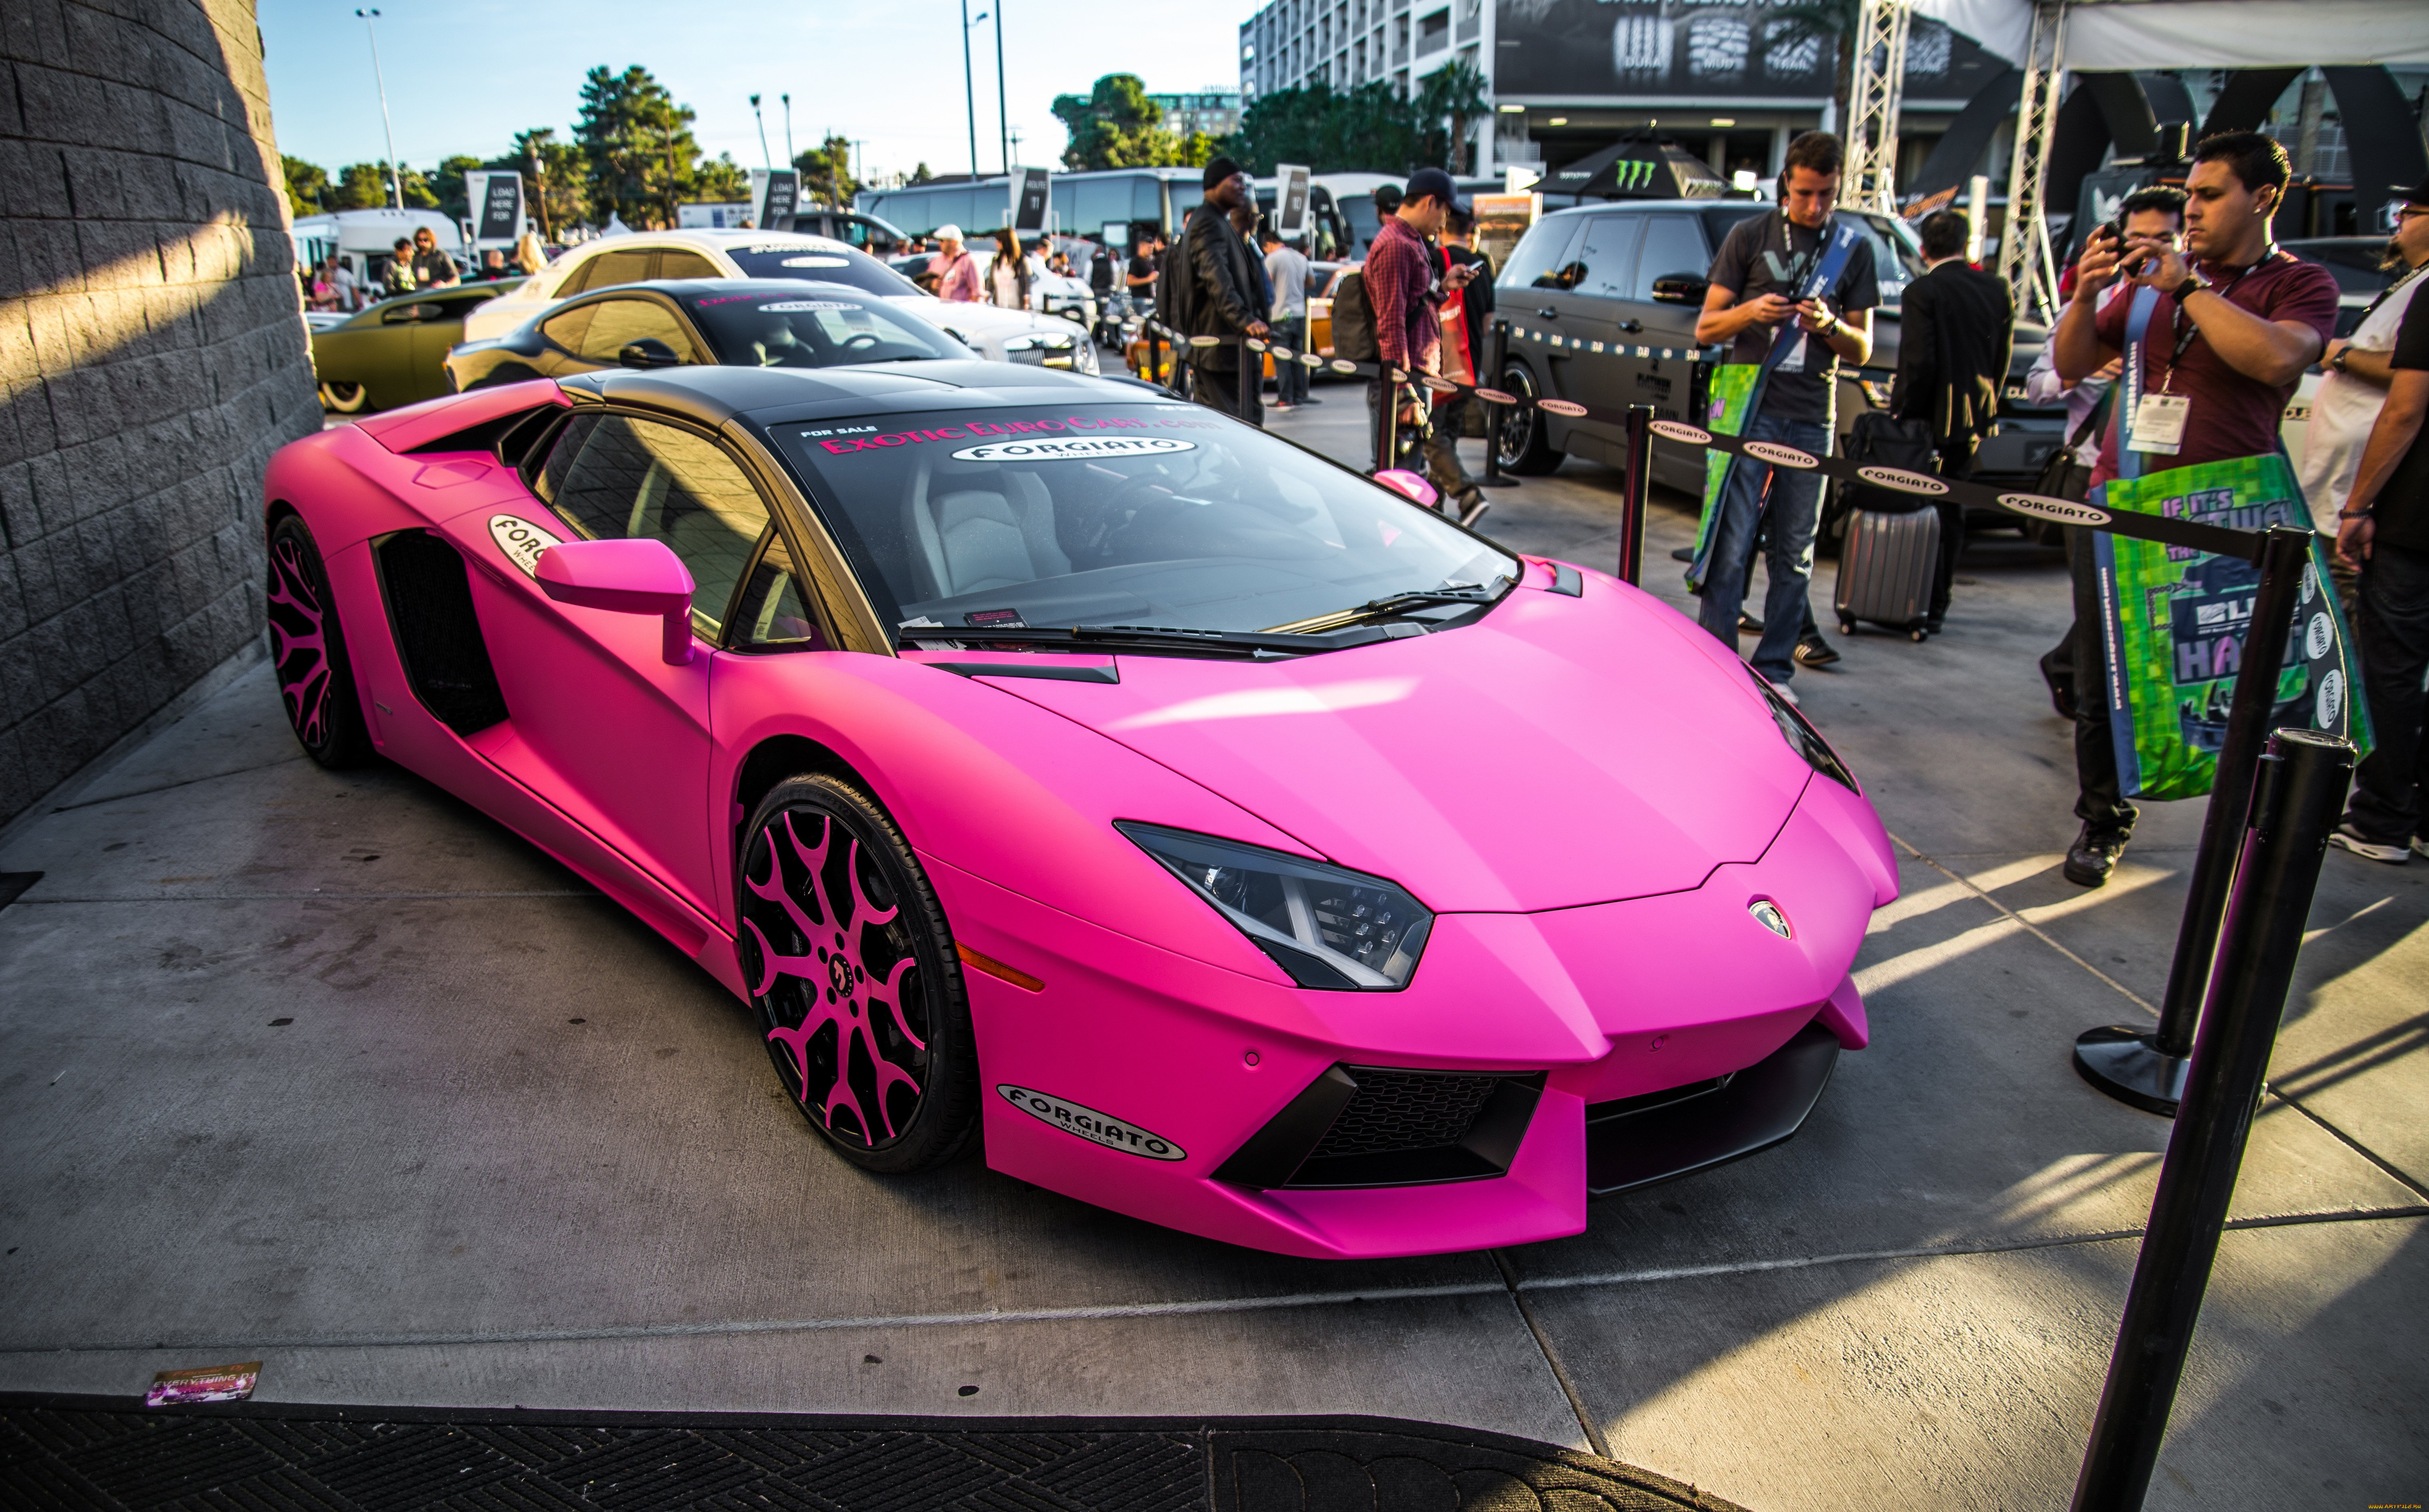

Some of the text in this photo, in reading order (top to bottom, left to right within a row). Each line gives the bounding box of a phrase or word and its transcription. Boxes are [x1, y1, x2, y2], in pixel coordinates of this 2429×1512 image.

[773, 183, 794, 192] LOAD
[1026, 180, 1047, 190] ROUTE
[492, 187, 516, 198] LOAD
[491, 199, 514, 210] HERE
[772, 194, 792, 204] HERE
[492, 211, 511, 222] FOR
[772, 206, 788, 215] FOR
[1424, 379, 1456, 390] FORGIATO
[1477, 390, 1515, 402] FORGIATO
[1542, 401, 1585, 413] FORGIATO
[836, 425, 879, 434] SALE
[1654, 423, 1708, 440] FORGIATO
[971, 440, 1179, 458] FORGIATO
[1749, 444, 1814, 465] FORGIATO
[1865, 469, 1943, 491] FORGIATO
[2006, 496, 2104, 521] FORGIATO
[2162, 497, 2183, 518] IF
[1010, 1089, 1170, 1154] FORGIATO
[1060, 1120, 1114, 1146] WHEELS
[153, 1374, 236, 1388] EVERYTHING
